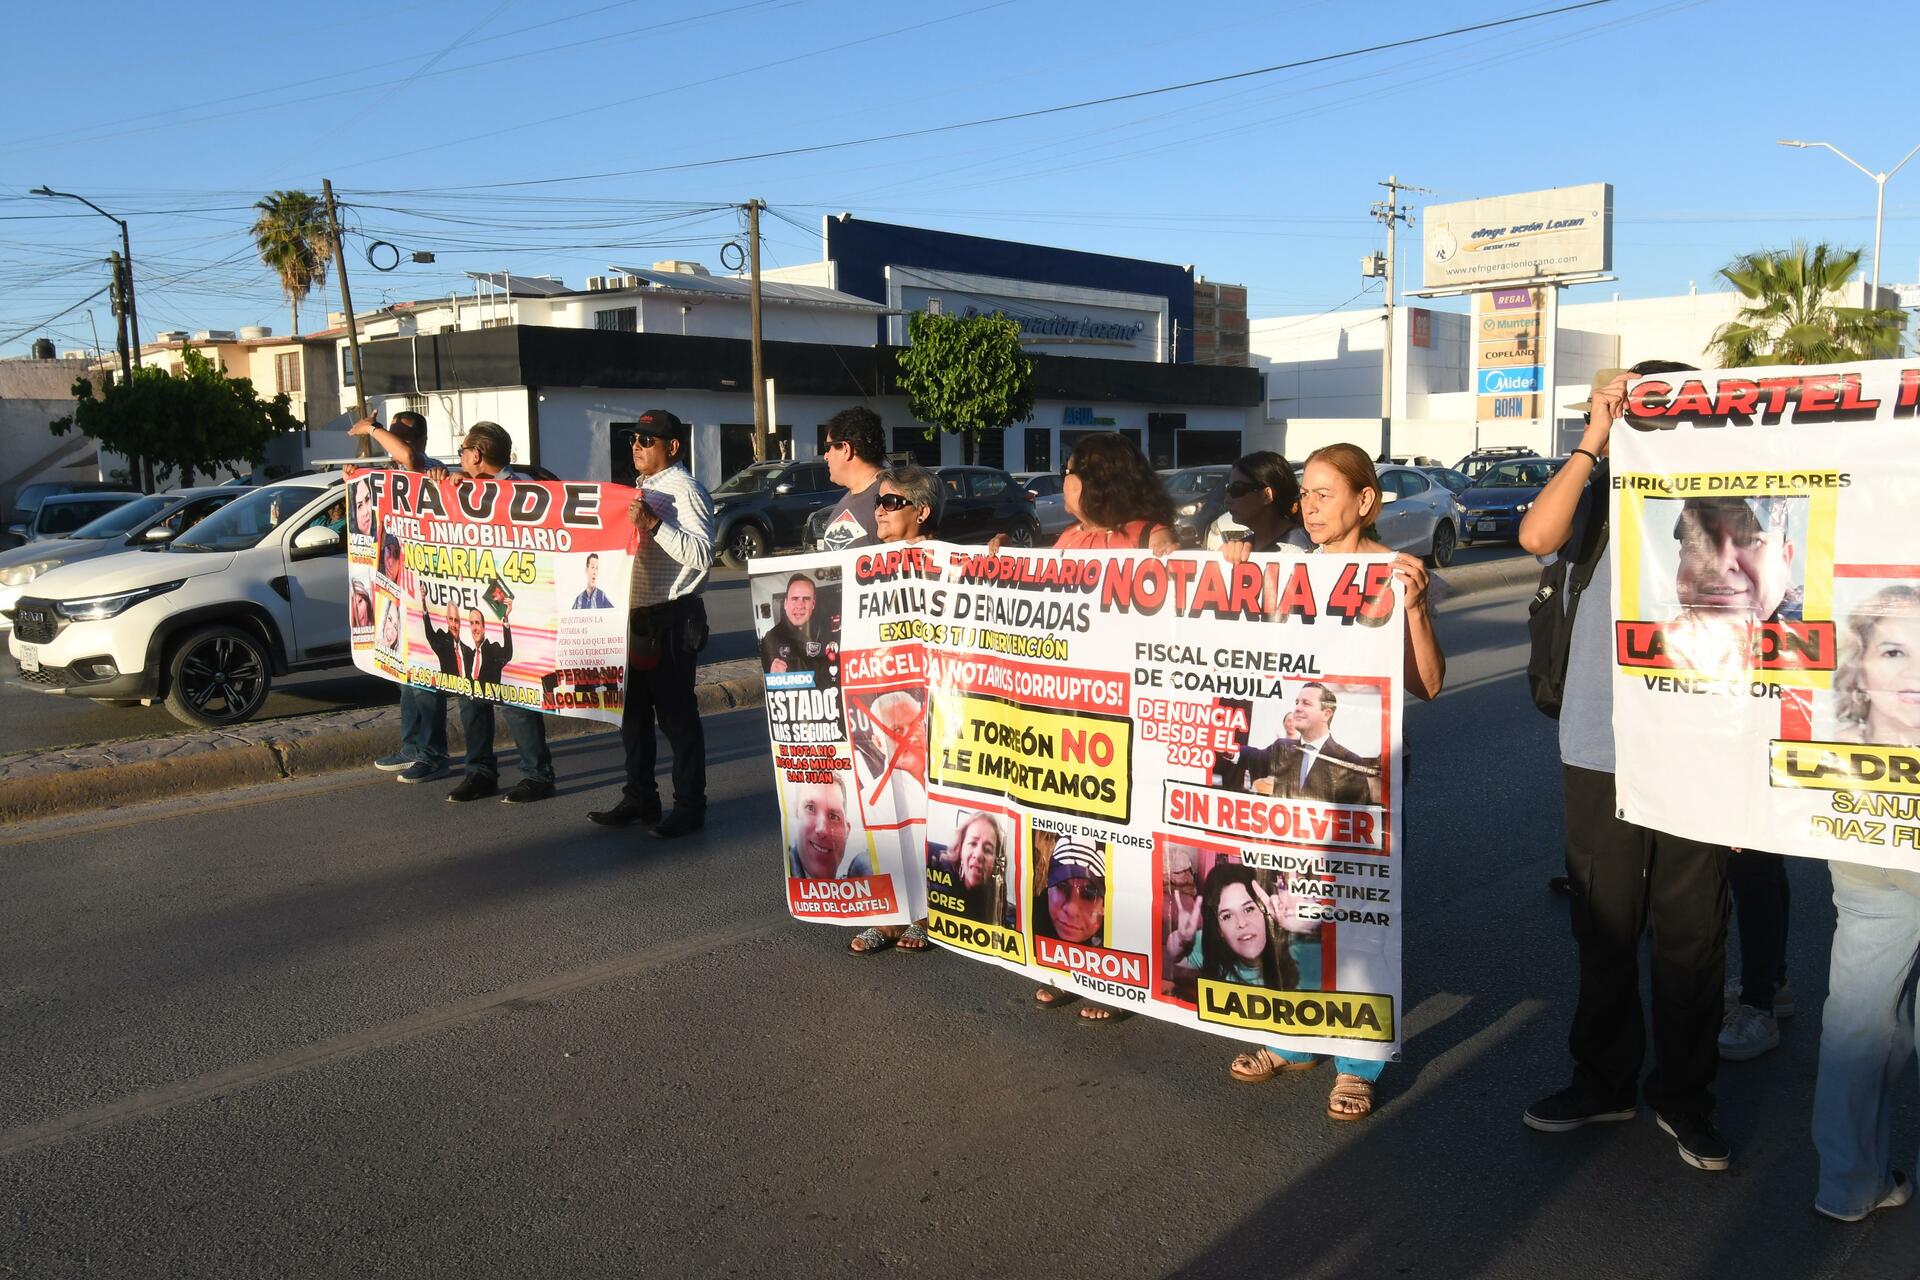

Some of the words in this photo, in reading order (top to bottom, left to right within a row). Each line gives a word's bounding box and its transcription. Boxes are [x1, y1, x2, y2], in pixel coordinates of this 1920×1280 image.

[1446, 255, 1578, 275] www.refrigeracionlozano.com
[1498, 295, 1526, 304] REGAL
[1485, 349, 1535, 359] COPELAND
[1494, 377, 1537, 389] Midea
[1494, 397, 1523, 418] BOHN
[1624, 372, 1881, 432] CARTEL
[1612, 475, 1702, 493] ENRIQUE
[1708, 475, 1758, 489] DIAZ
[1765, 473, 1851, 489] FLORES
[369, 471, 603, 530] FRAUDE
[383, 514, 426, 541] CARTEL
[428, 521, 572, 552] INMOBILIARIO
[403, 540, 497, 580] NOTARIA
[503, 550, 536, 584] 45
[855, 547, 943, 586] CARTEL
[1100, 558, 1316, 625] NOTARIA
[1326, 562, 1395, 628] 45
[591, 638, 606, 647] QUE
[565, 659, 578, 667] CON
[1135, 642, 1207, 666] FISCAL
[1214, 649, 1321, 674] GENERAL
[556, 666, 624, 685] FERNANDO
[845, 652, 921, 684] ¡CÁRCEL
[1015, 671, 1124, 707] CORRUPTOS!
[1134, 667, 1163, 688] DE
[1170, 670, 1283, 700] COAHUILA
[473, 680, 483, 699] A
[484, 682, 541, 709] AYUDAR!
[542, 691, 600, 710] NICOLAS
[767, 688, 836, 722] ESTADO
[1138, 699, 1248, 731] DENUNCIA
[792, 722, 839, 742] SEGURO
[971, 719, 1054, 759] TORREÓN
[1061, 728, 1114, 767] NO
[1142, 720, 1211, 746] DESDE
[1214, 732, 1239, 752] EL
[789, 745, 836, 757] NOTARIO
[810, 756, 852, 770] MUÑOZ
[1167, 744, 1215, 768] 2020
[787, 771, 804, 783] SAN
[806, 771, 833, 784] JUAN
[943, 749, 972, 772] LE
[977, 752, 1117, 803] IMPORTAMOS
[1170, 788, 1208, 825] SIN
[1217, 796, 1375, 845] RESOLVER
[1811, 816, 1886, 845] DIAZ
[1032, 816, 1078, 836] ENRIQUE
[1081, 826, 1108, 842] DIAZ
[1110, 832, 1153, 850] FLORES
[1242, 850, 1308, 871] WENDY
[1314, 857, 1390, 878] LIZETTE
[800, 880, 871, 900] LADRON
[1290, 880, 1390, 903] MARTINEZ
[794, 900, 820, 913] (LIDER
[822, 901, 840, 913] DEL
[840, 897, 890, 913] CARTEL)
[1298, 905, 1390, 926] ESCOBAR
[1040, 940, 1140, 981] LADRON
[1072, 970, 1146, 1003] VENDEDOR
[1205, 987, 1382, 1032] LADRONA
